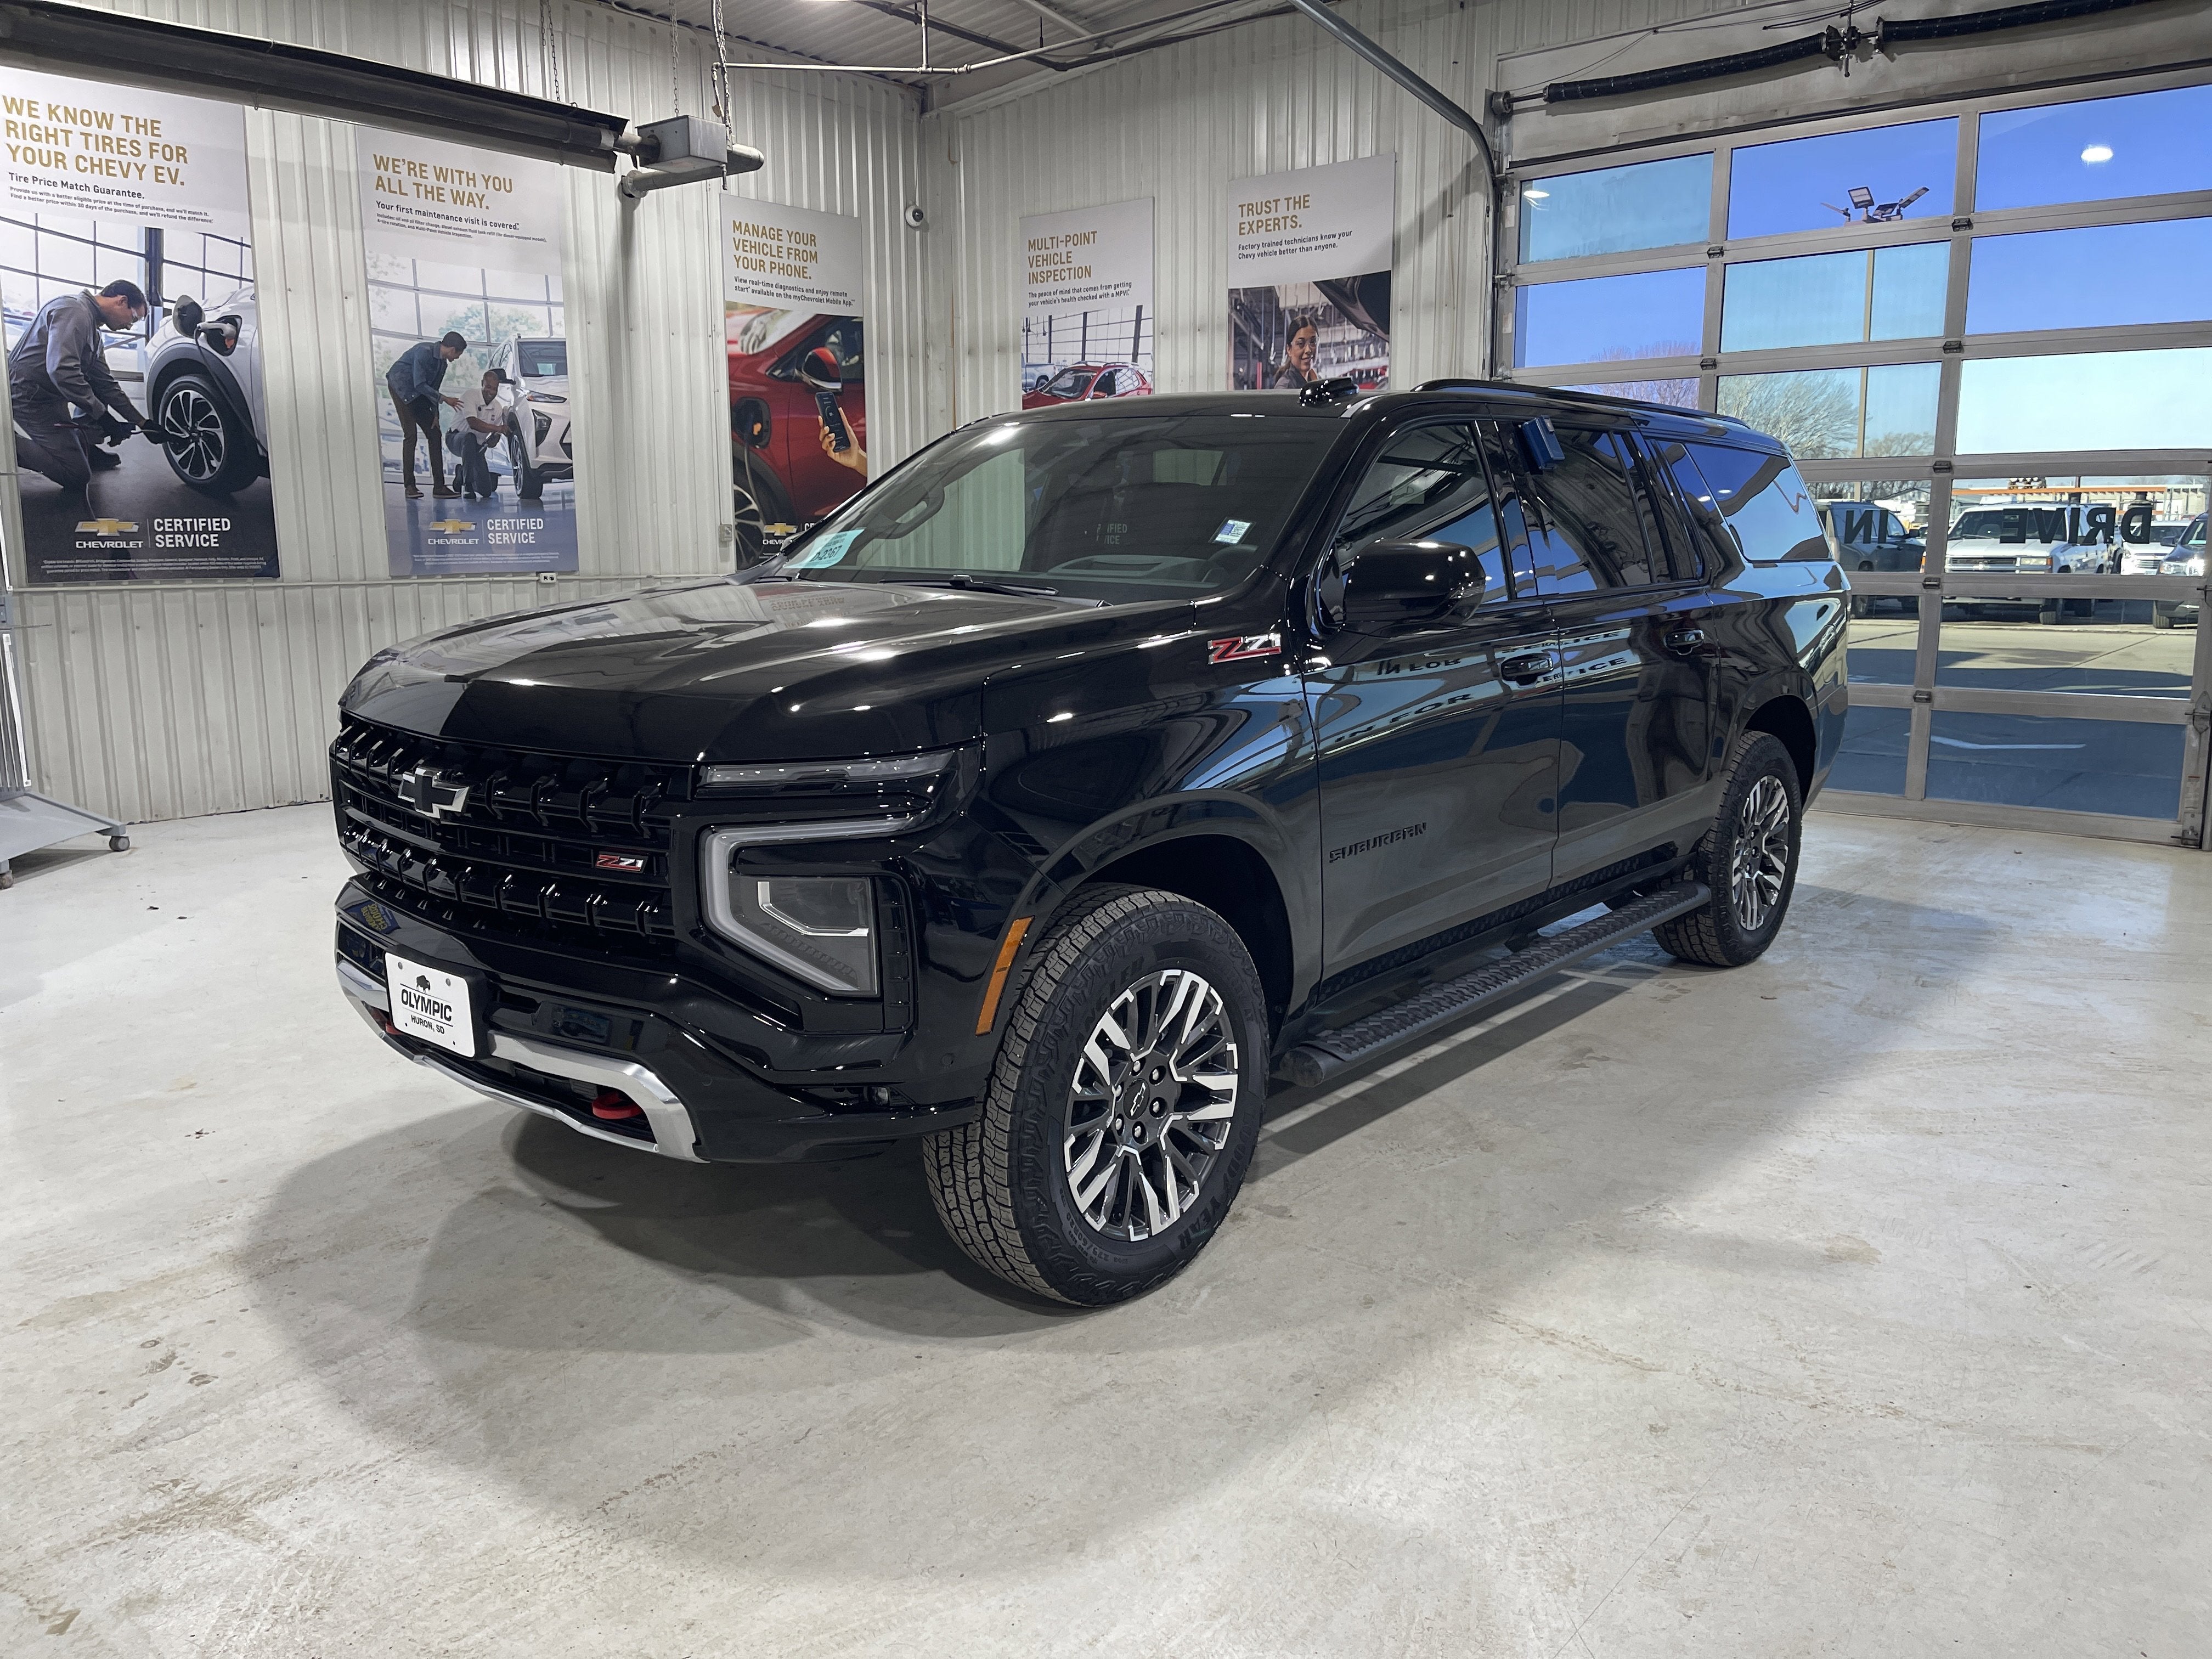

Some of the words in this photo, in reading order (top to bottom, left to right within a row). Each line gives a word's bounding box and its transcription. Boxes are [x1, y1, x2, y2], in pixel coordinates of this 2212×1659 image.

[2, 95, 40, 119] WE
[48, 103, 114, 131] KNOW
[120, 114, 162, 138] THE
[5, 119, 73, 147] RIGHT
[80, 132, 142, 157] TIRES
[149, 142, 188, 164] FOR
[5, 143, 67, 170] YOUR
[75, 155, 146, 180] CHEVY
[154, 165, 184, 186] EV.
[373, 154, 428, 179] WE'RE
[432, 165, 476, 188] WITH
[481, 173, 512, 193] YOU
[8, 172, 29, 183] Tire
[32, 176, 58, 187] Price
[61, 180, 90, 192] Match
[93, 184, 144, 199] Guarantee.
[375, 175, 408, 196] ALL
[412, 182, 445, 202] THE
[450, 188, 489, 210] WAY.
[376, 200, 394, 210] Your
[396, 204, 413, 215] first
[415, 210, 462, 222] maintenance
[464, 216, 479, 225] visit
[481, 218, 487, 226] is
[1238, 198, 1280, 218] TRUST
[1284, 194, 1310, 211] THE
[732, 219, 783, 242] MANAGE
[786, 229, 816, 247] YOUR
[1239, 215, 1302, 236] EXPERTS.
[732, 236, 783, 259] VEHICLE
[787, 246, 817, 264] FROM
[1028, 230, 1097, 252] MULTI-POINT
[1257, 249, 1277, 257] vehicle
[1314, 242, 1338, 251] anyone.
[1262, 239, 1283, 248] trained
[1284, 235, 1318, 245] technicians
[1338, 230, 1352, 239] your
[733, 254, 766, 273] YOUR
[770, 261, 811, 280] PHONE.
[1028, 251, 1072, 268] VEHICLE
[734, 275, 747, 284] View
[748, 279, 773, 288] real-time
[775, 282, 804, 292] diagnostics
[815, 289, 828, 297] enjoy
[1029, 265, 1091, 285] INSPECTION
[1113, 281, 1132, 290] getting
[751, 289, 774, 297] available
[1077, 293, 1097, 301] checked
[154, 518, 232, 532] CERTIFIED
[487, 518, 544, 531] CERTIFIED
[75, 540, 144, 549] CHEVROLET
[155, 534, 219, 548] SERVICE
[488, 532, 535, 544] SERVICE
[1207, 633, 1282, 665] Z71
[1329, 822, 1427, 864] SUBURBAN
[596, 854, 644, 872] Z71
[400, 989, 453, 1022] OLYMPIC
[410, 1014, 435, 1032] HURON,
[436, 1025, 445, 1035] SD
